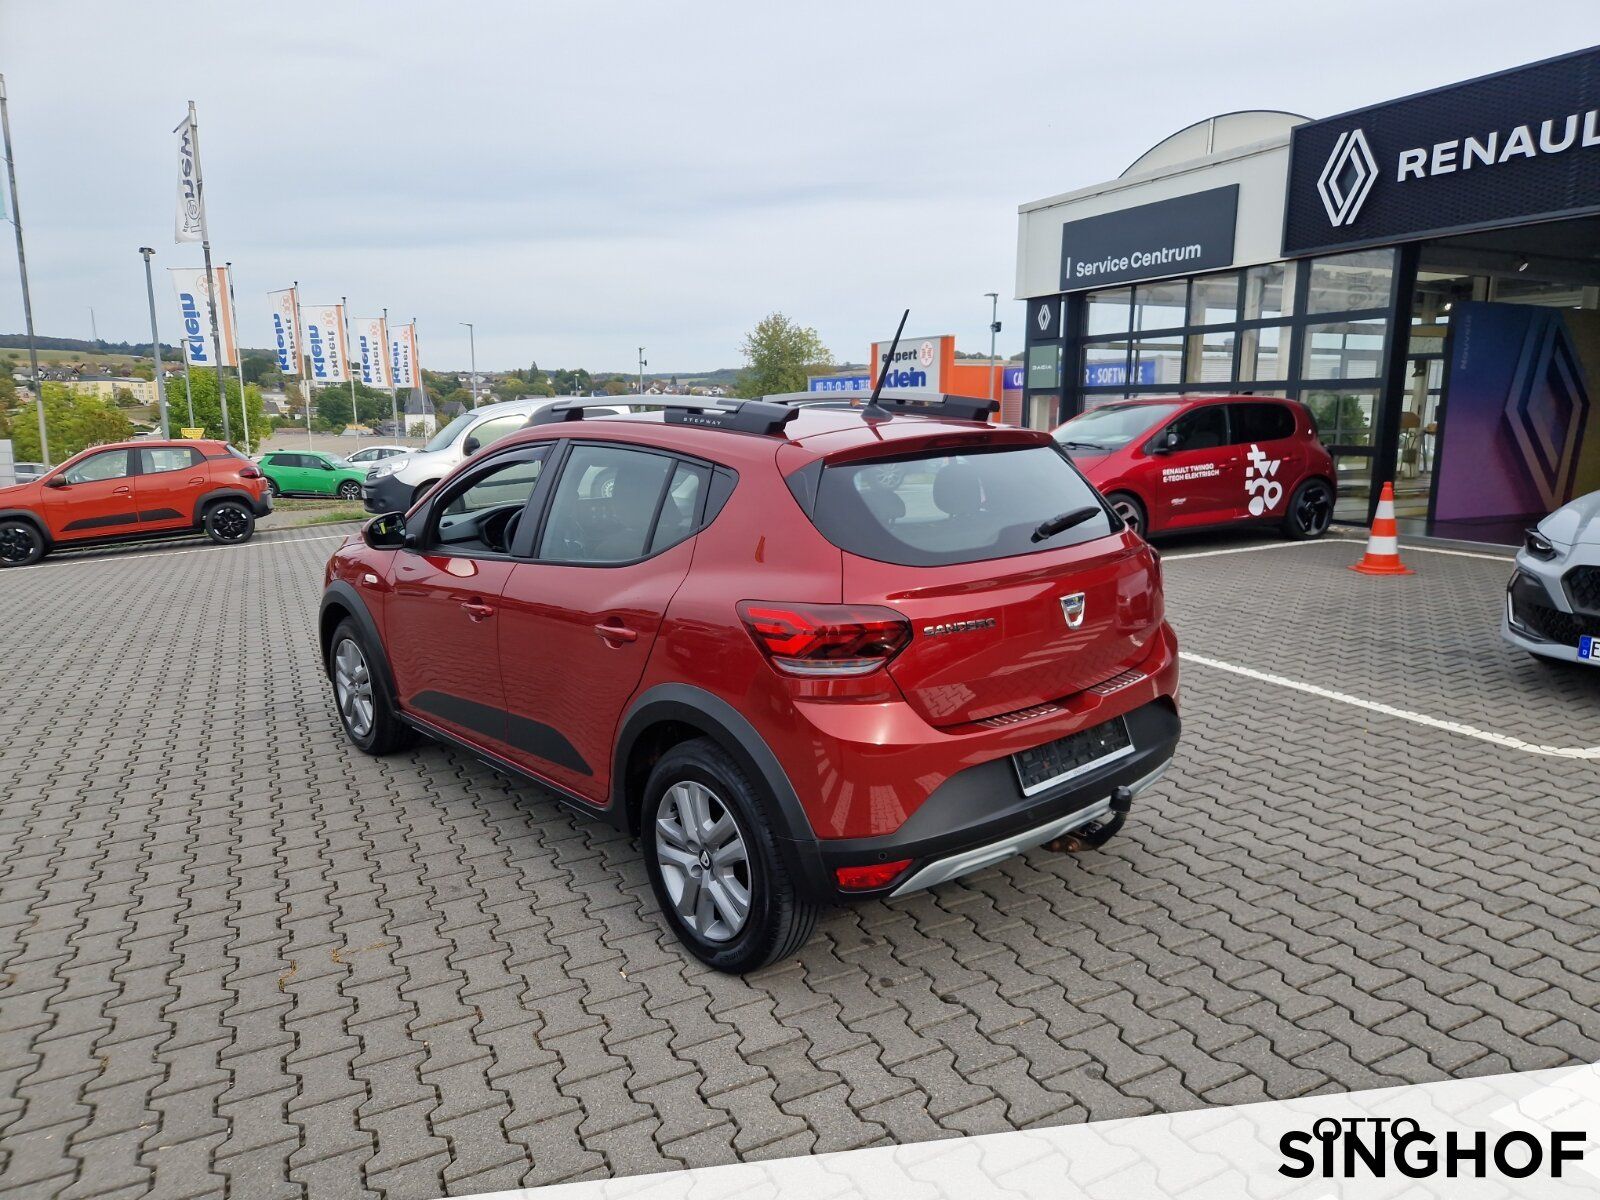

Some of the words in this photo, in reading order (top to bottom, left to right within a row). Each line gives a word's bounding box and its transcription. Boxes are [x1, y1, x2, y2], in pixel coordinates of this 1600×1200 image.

[1076, 256, 1129, 278] Service
[1130, 244, 1201, 268] Centrum
[882, 367, 926, 388] klein
[1097, 366, 1143, 384] SOFTWE
[683, 417, 721, 426] STEPWAY
[1162, 466, 1189, 476] RENAULT
[1190, 463, 1214, 472] TWINGO
[1163, 474, 1184, 483] E-TECH
[1184, 469, 1220, 480] ELEKTRISCH
[924, 618, 996, 636] SANDERO
